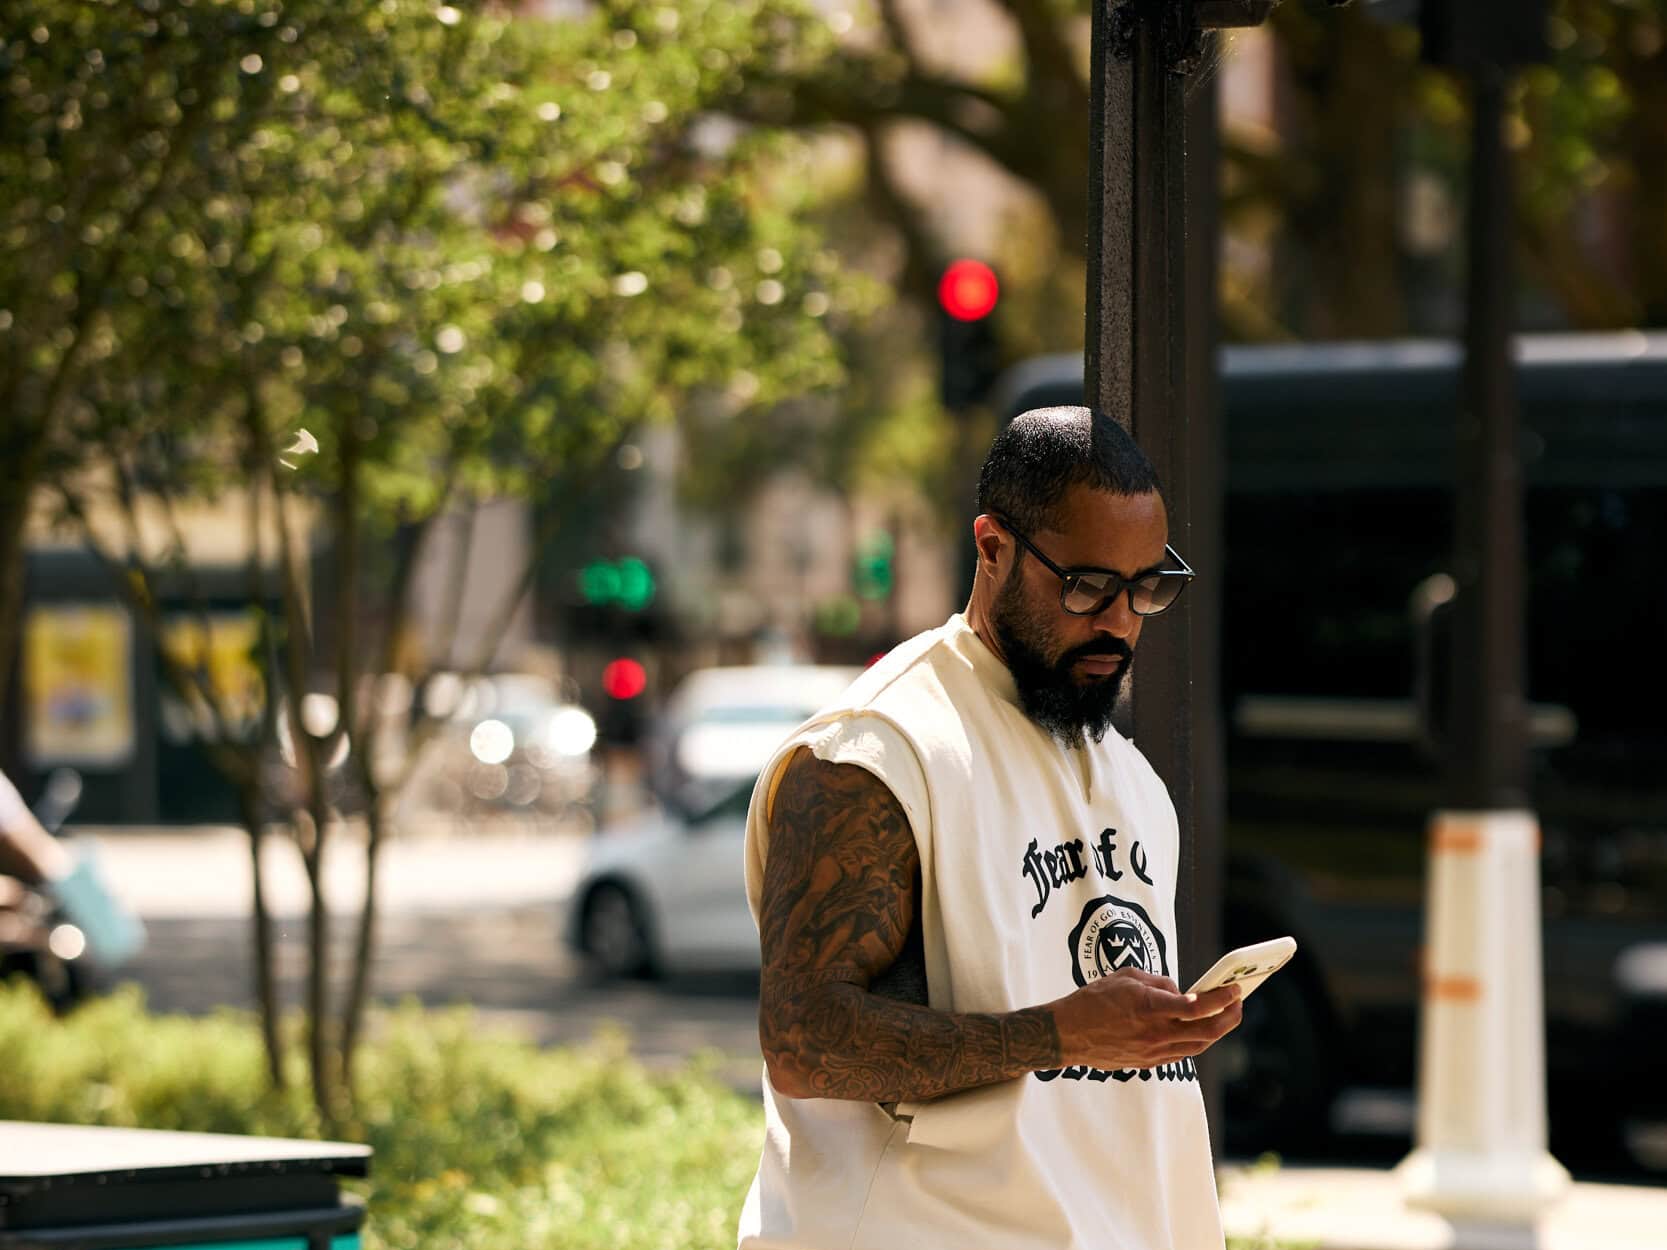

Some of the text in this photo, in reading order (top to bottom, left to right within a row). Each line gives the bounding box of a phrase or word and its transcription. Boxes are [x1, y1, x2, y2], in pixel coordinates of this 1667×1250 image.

[1023, 837, 1088, 919] Fear
[1083, 935, 1094, 959] FEAR
[1090, 919, 1101, 933] OF
[1087, 969, 1098, 979] 19
